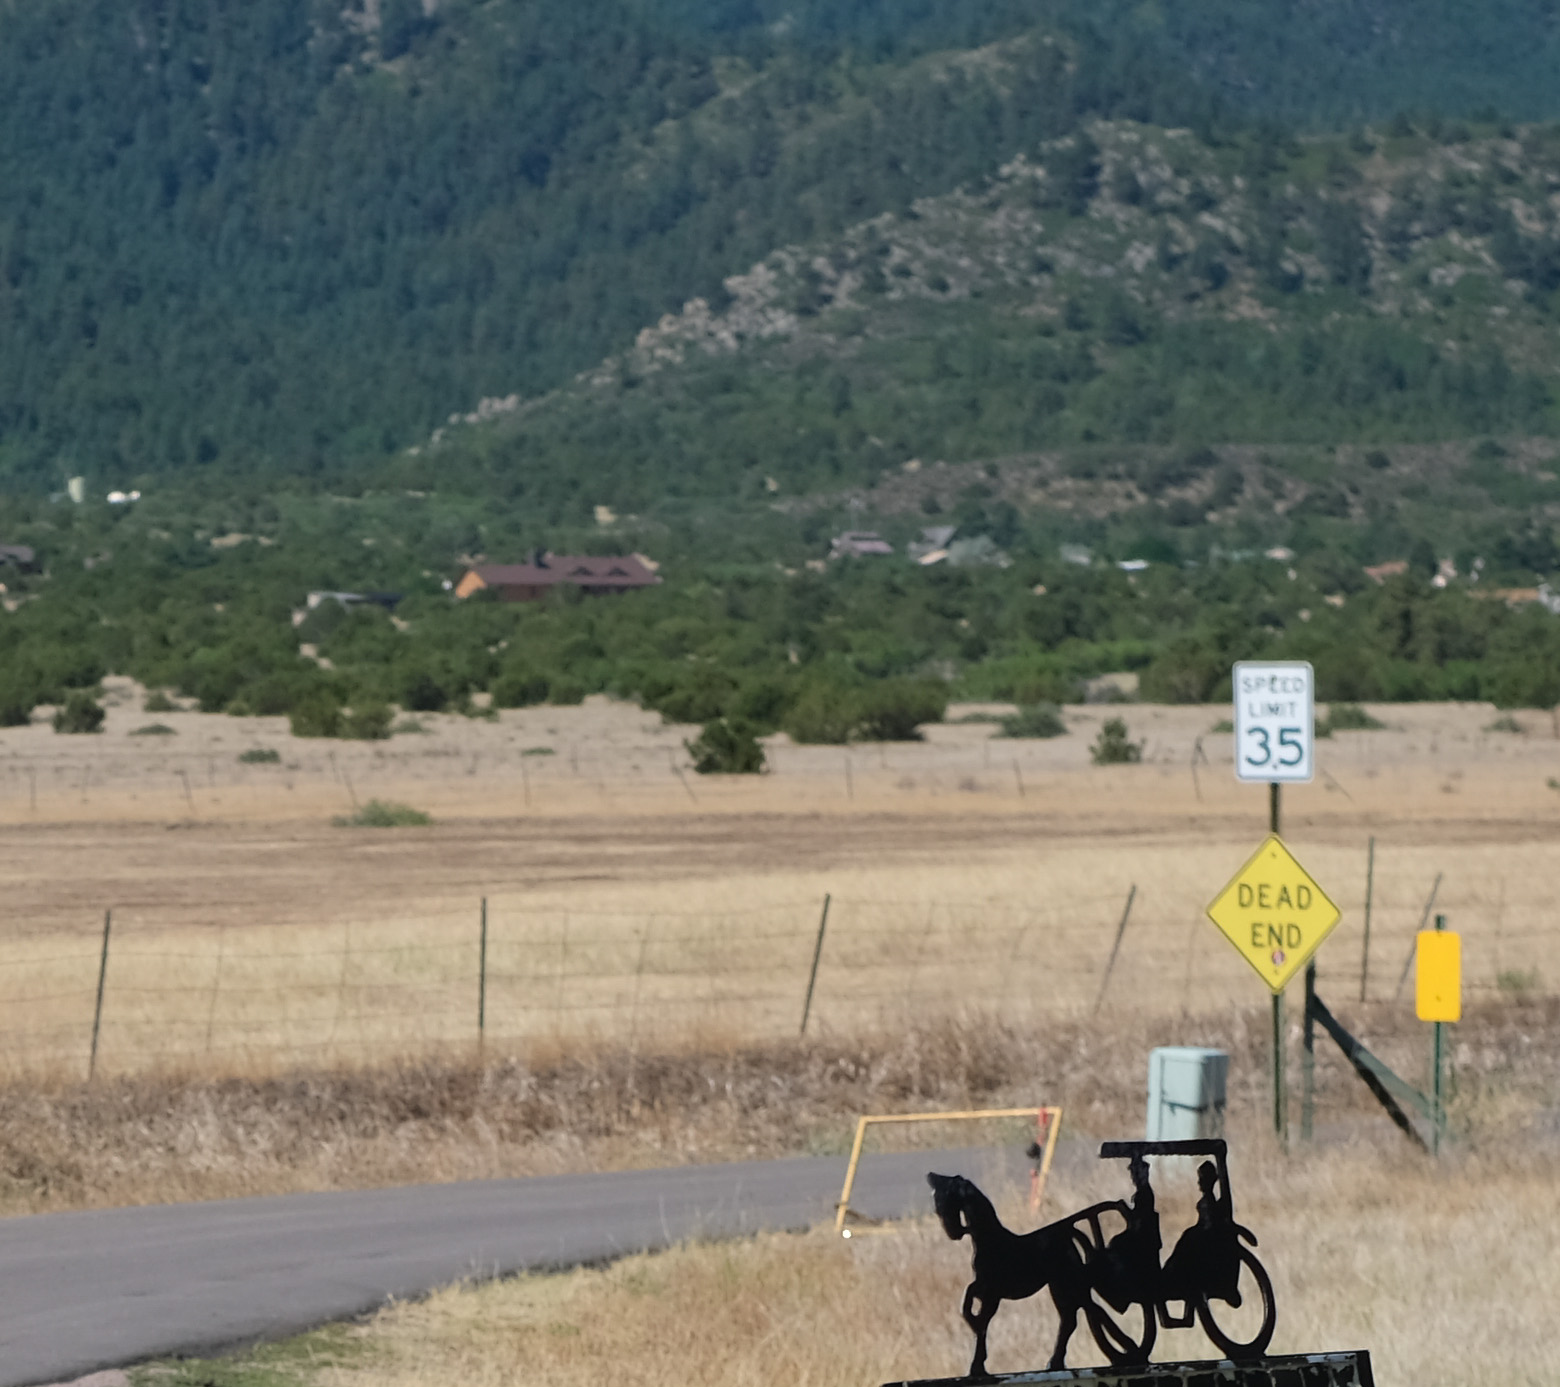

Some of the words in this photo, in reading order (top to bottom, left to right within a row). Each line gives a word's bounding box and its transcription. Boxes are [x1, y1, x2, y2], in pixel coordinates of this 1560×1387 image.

[1242, 676, 1304, 694] SPEED
[1248, 702, 1296, 718] LIMIT
[1246, 727, 1304, 766] 35
[1238, 883, 1312, 910] DEAD
[1251, 923, 1302, 949] END
